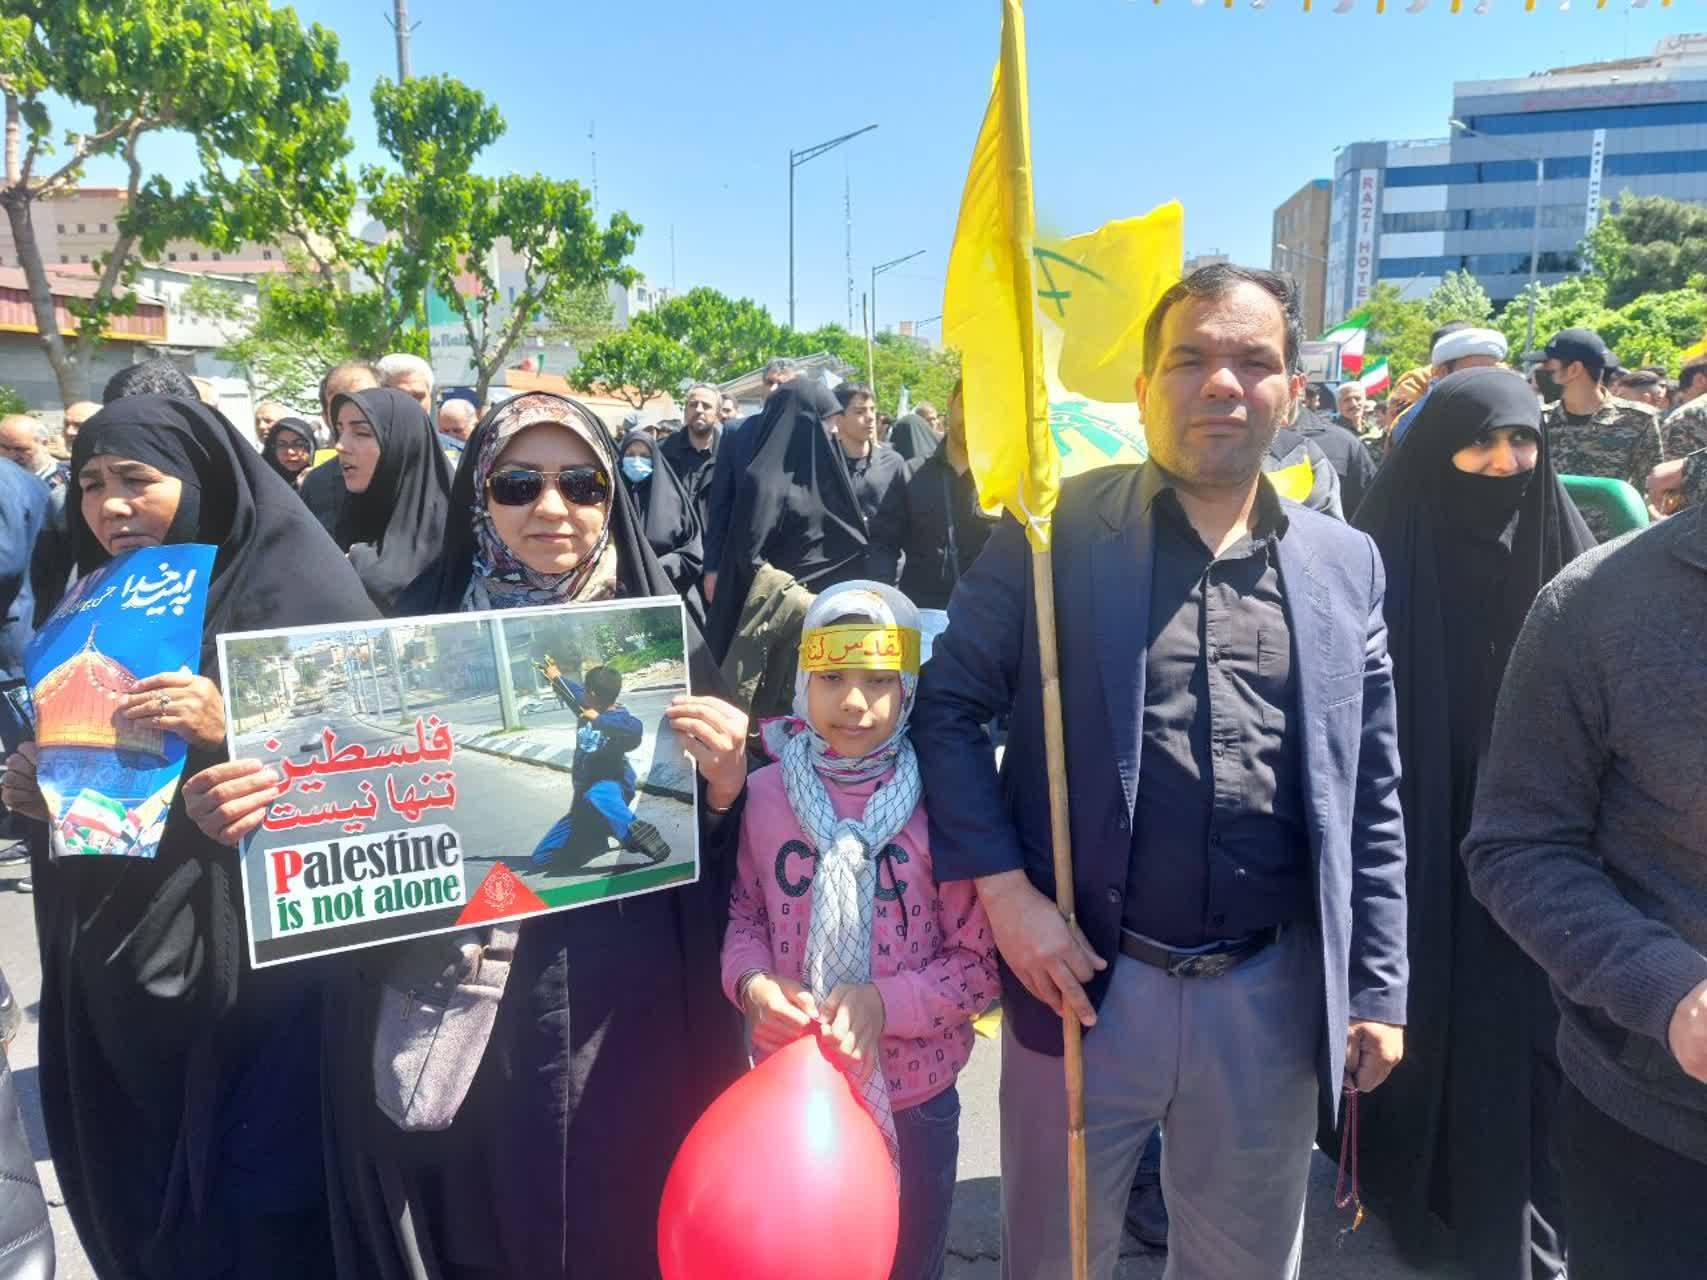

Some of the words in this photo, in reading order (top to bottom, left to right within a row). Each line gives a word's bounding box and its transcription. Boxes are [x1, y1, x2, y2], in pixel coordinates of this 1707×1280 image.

[1360, 176, 1373, 232] RAZI
[1357, 240, 1370, 298] HOTE
[262, 779, 379, 832] نیست
[385, 772, 457, 822] تنها
[271, 831, 460, 895] Palestine
[276, 897, 304, 931] is
[312, 884, 364, 926] not
[374, 874, 461, 915] alone
